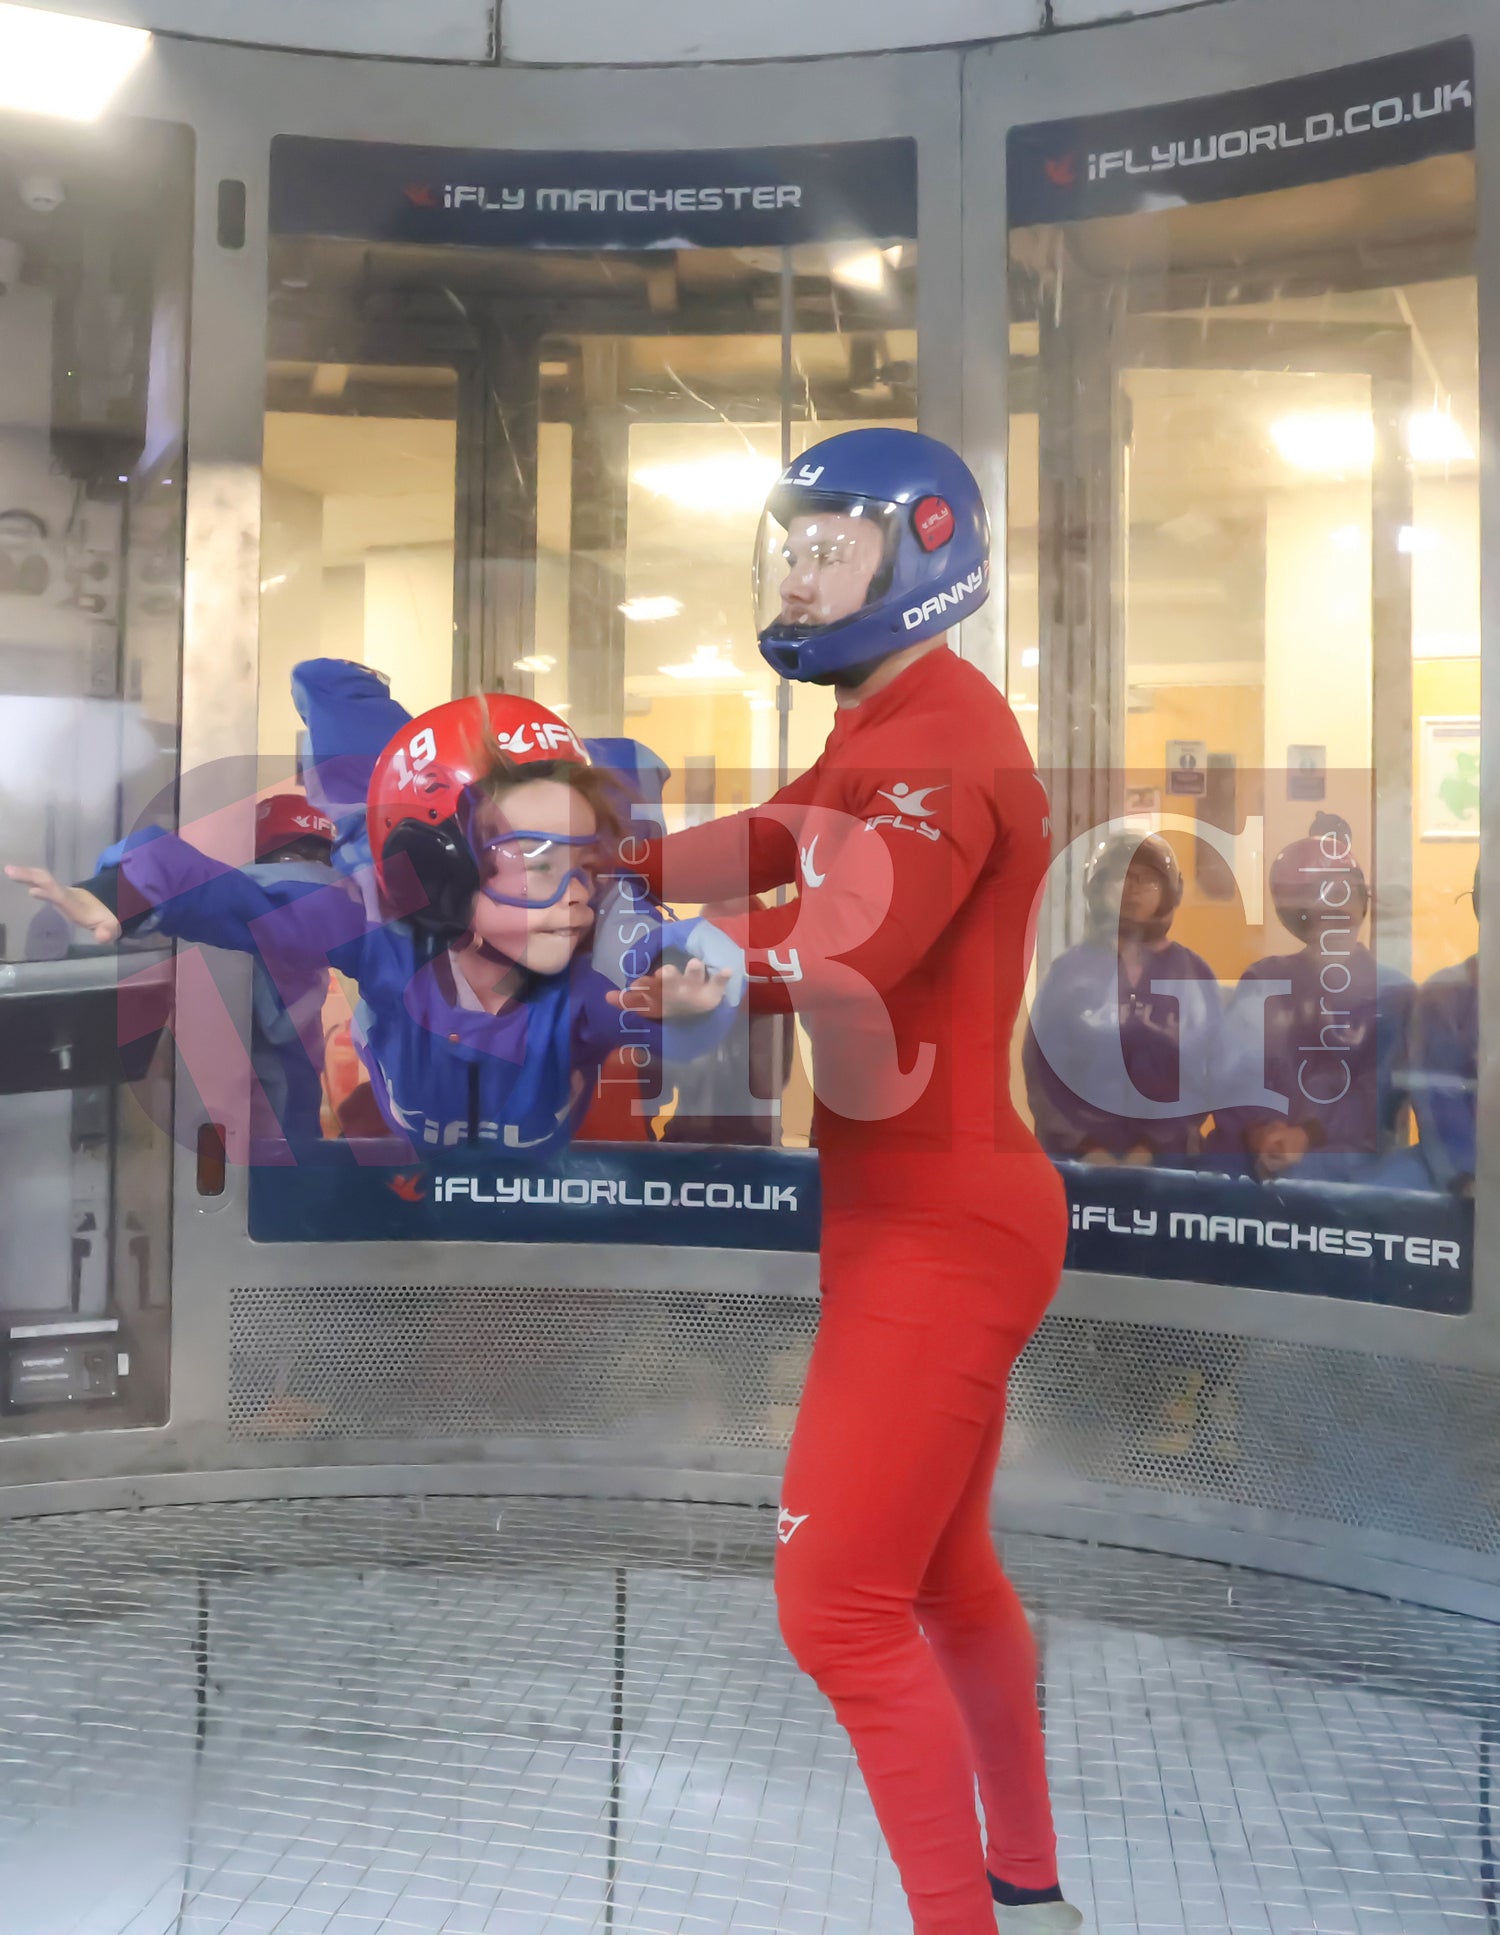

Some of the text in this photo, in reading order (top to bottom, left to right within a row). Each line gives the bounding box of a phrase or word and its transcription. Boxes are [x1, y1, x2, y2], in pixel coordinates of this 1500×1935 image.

[1088, 80, 1472, 181] iFLYWORLD.CO.UK
[444, 185, 802, 213] iFLY MANCHESTER
[903, 566, 982, 630] DANNY
[392, 727, 437, 791] 19
[424, 1106, 568, 1148] iFL
[434, 1176, 798, 1212] iFLYWORLD.CO.UK
[1072, 1203, 1461, 1270] iFLY MANCHESTER
